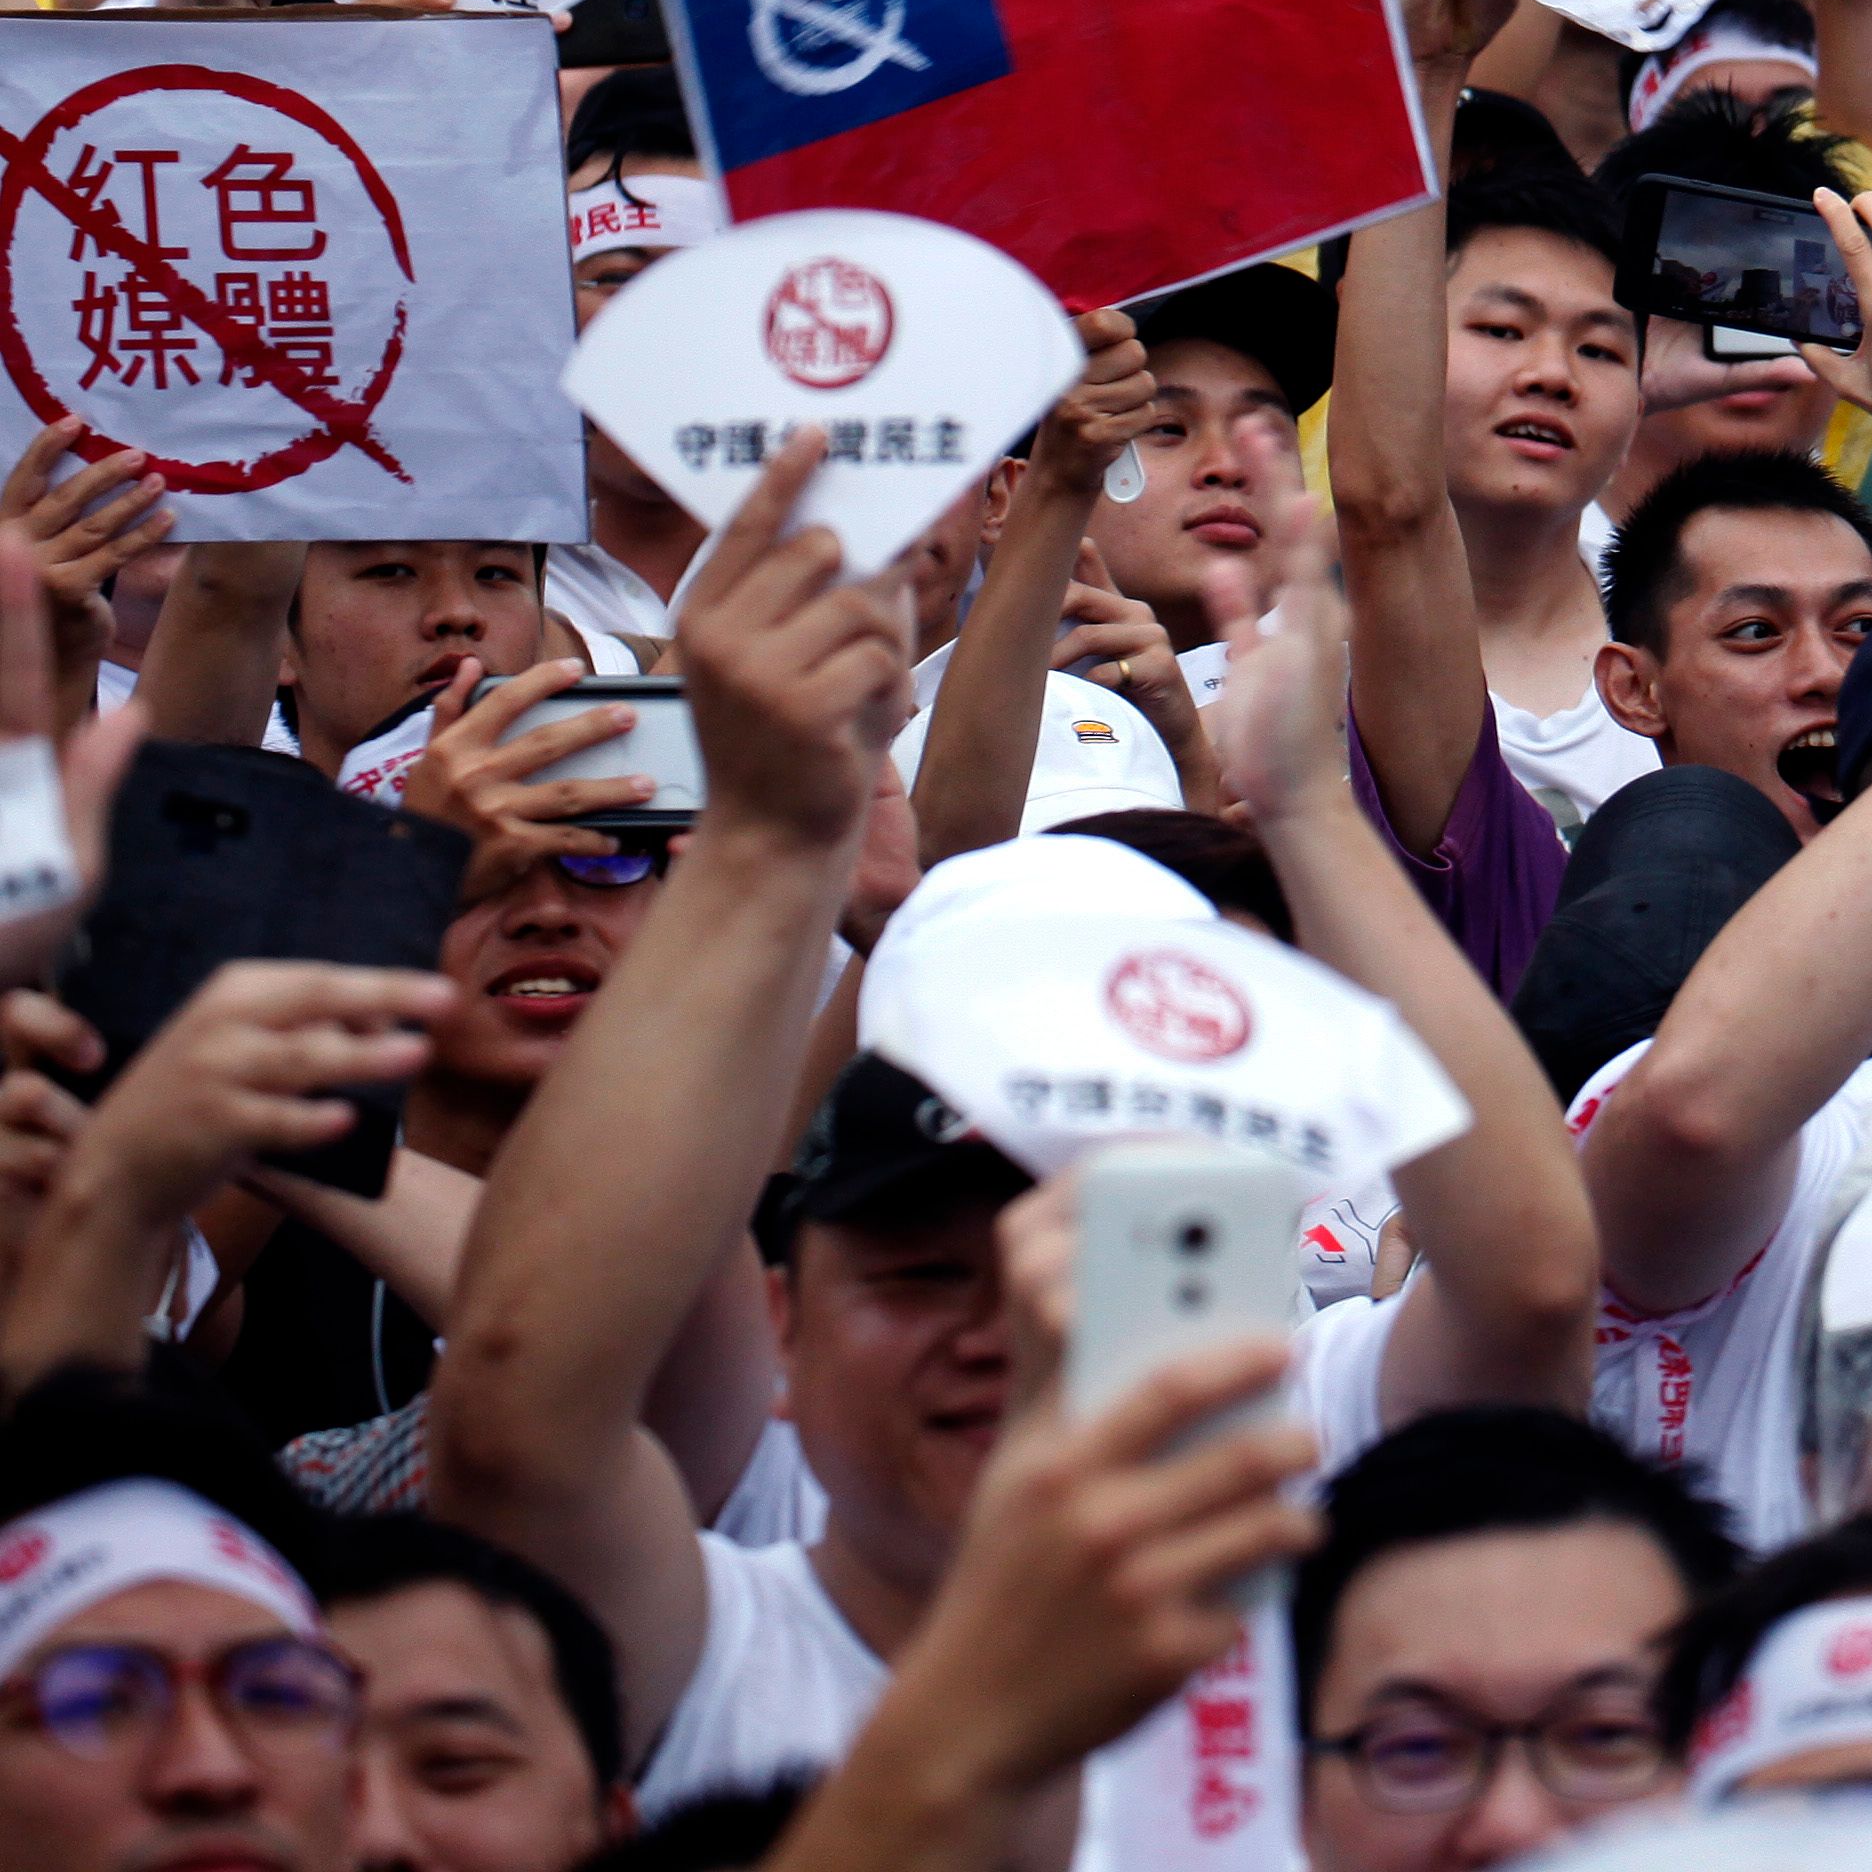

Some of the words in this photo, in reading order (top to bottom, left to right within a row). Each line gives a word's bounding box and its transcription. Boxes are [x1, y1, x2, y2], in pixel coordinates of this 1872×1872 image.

[67, 144, 328, 262] 紅色
[569, 202, 663, 245] 民主
[72, 271, 340, 392] 媒體
[676, 416, 965, 470] 守護灣民主
